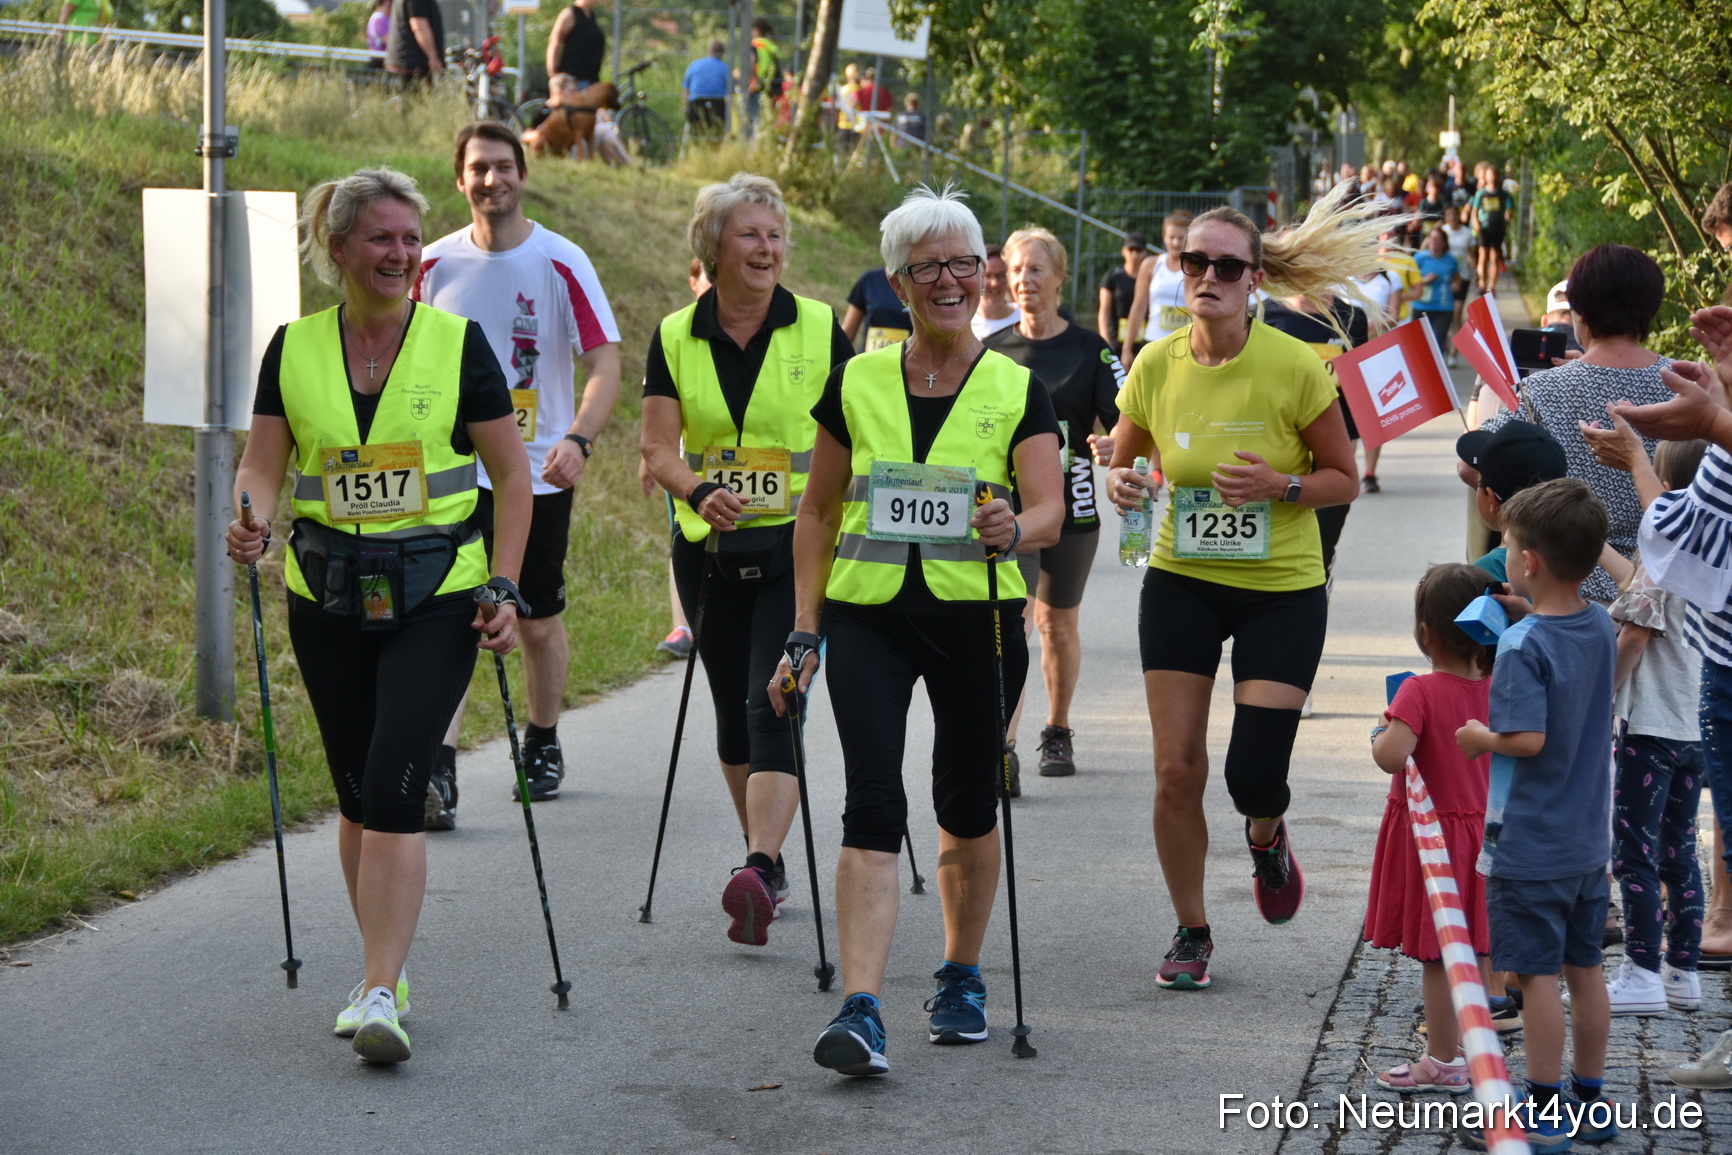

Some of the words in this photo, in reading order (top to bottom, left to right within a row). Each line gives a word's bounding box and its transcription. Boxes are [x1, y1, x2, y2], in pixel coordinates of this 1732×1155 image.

[1380, 414, 1399, 427] DEHN
[335, 459, 374, 469] firmenlauf
[335, 469, 411, 502] 1517
[713, 470, 778, 495] 1516
[885, 476, 923, 486] firmenlauf
[1070, 457, 1096, 517] now
[350, 501, 368, 509] Pröll
[370, 499, 400, 509] Claudia
[362, 507, 405, 515] Postbauer-Heng
[890, 497, 949, 526] 9103
[1123, 518, 1138, 526] PLUS
[1186, 512, 1257, 539] 1235
[379, 991, 391, 999] NIKE
